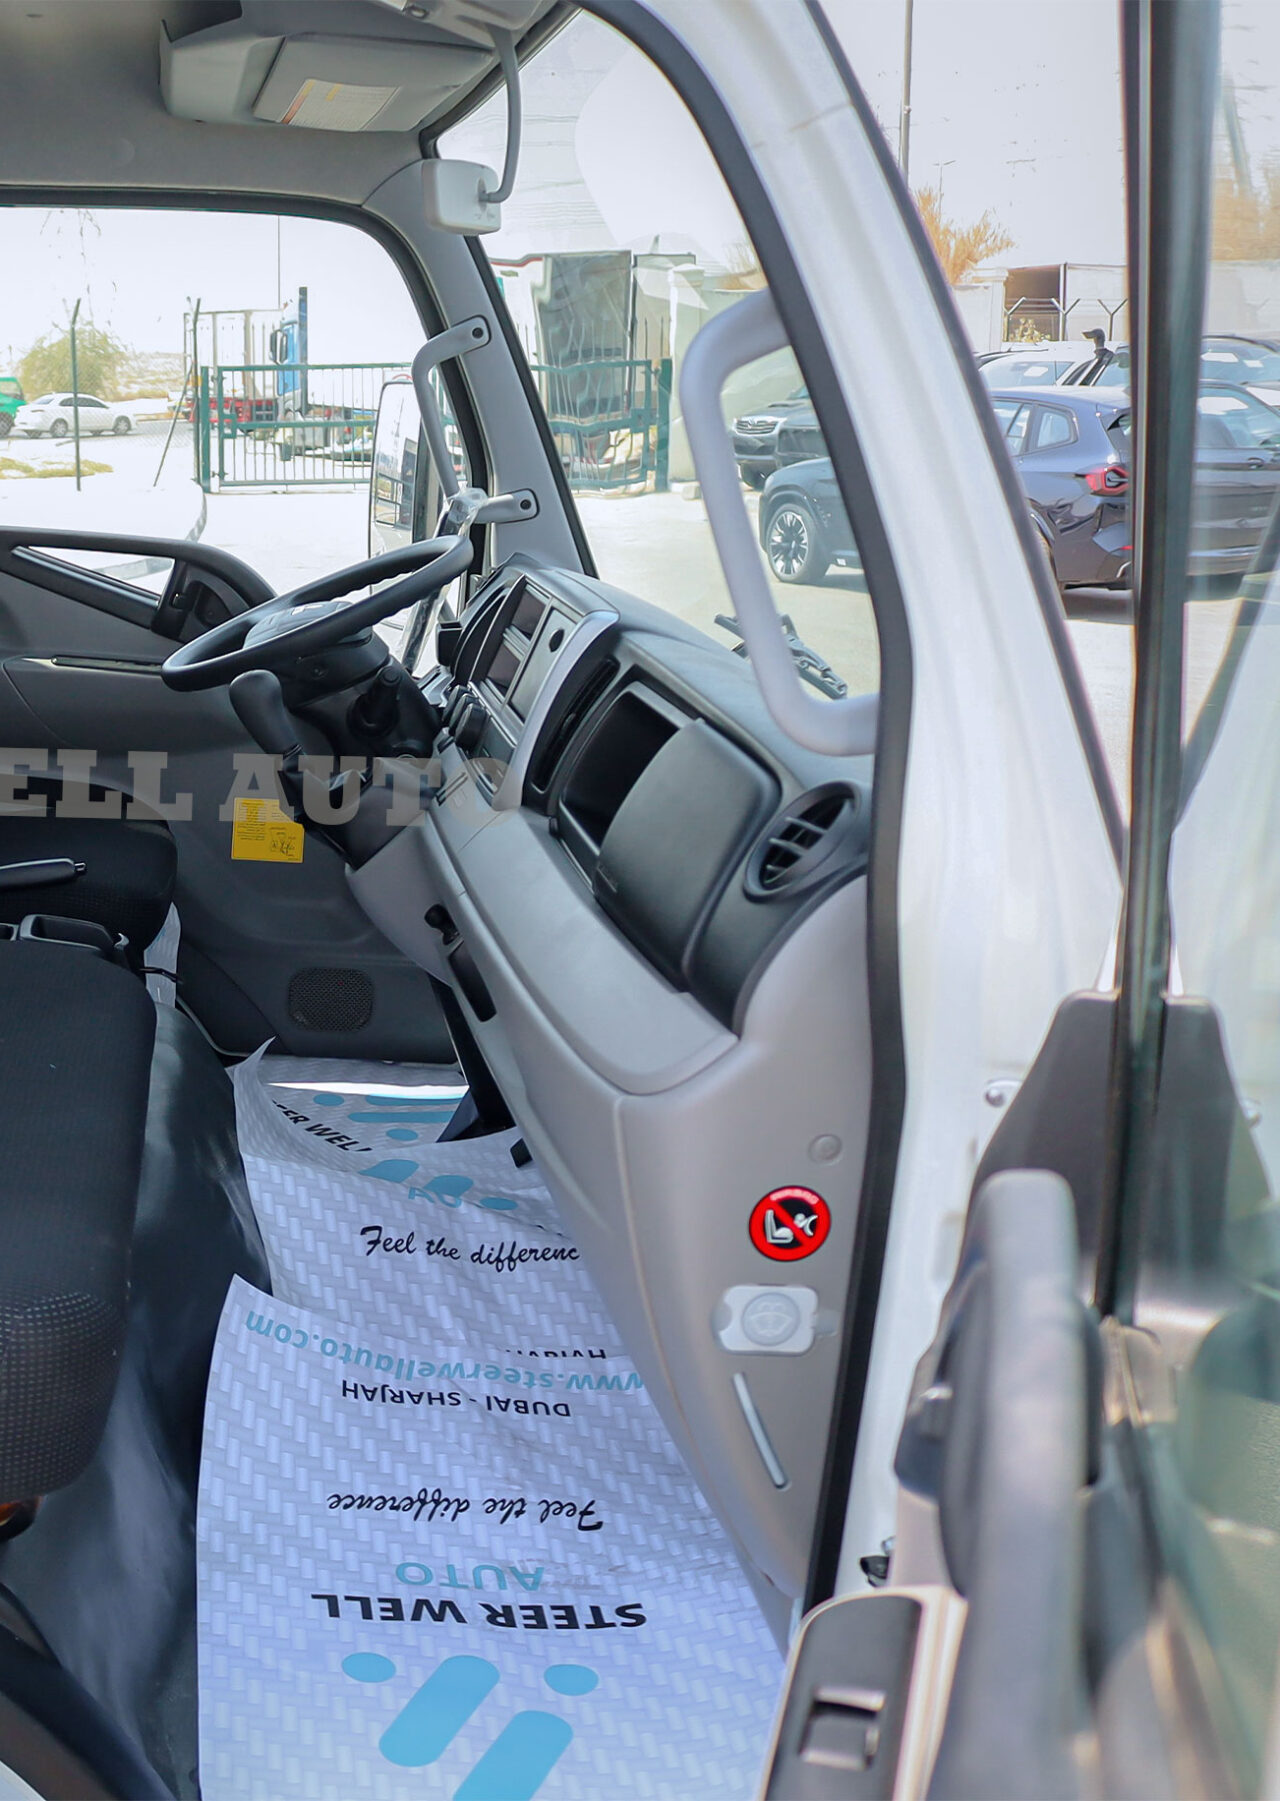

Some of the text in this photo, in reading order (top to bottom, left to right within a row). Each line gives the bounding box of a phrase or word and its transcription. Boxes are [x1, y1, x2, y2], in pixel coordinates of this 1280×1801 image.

[359, 1225, 580, 1273] Feel the differenc
[341, 1380, 462, 1407] SHARJAH
[486, 1395, 572, 1417] DUBAI
[326, 1488, 604, 1531] Feel the difference
[395, 1562, 545, 1591] AUTO
[311, 1594, 647, 1629] STEER WELL
